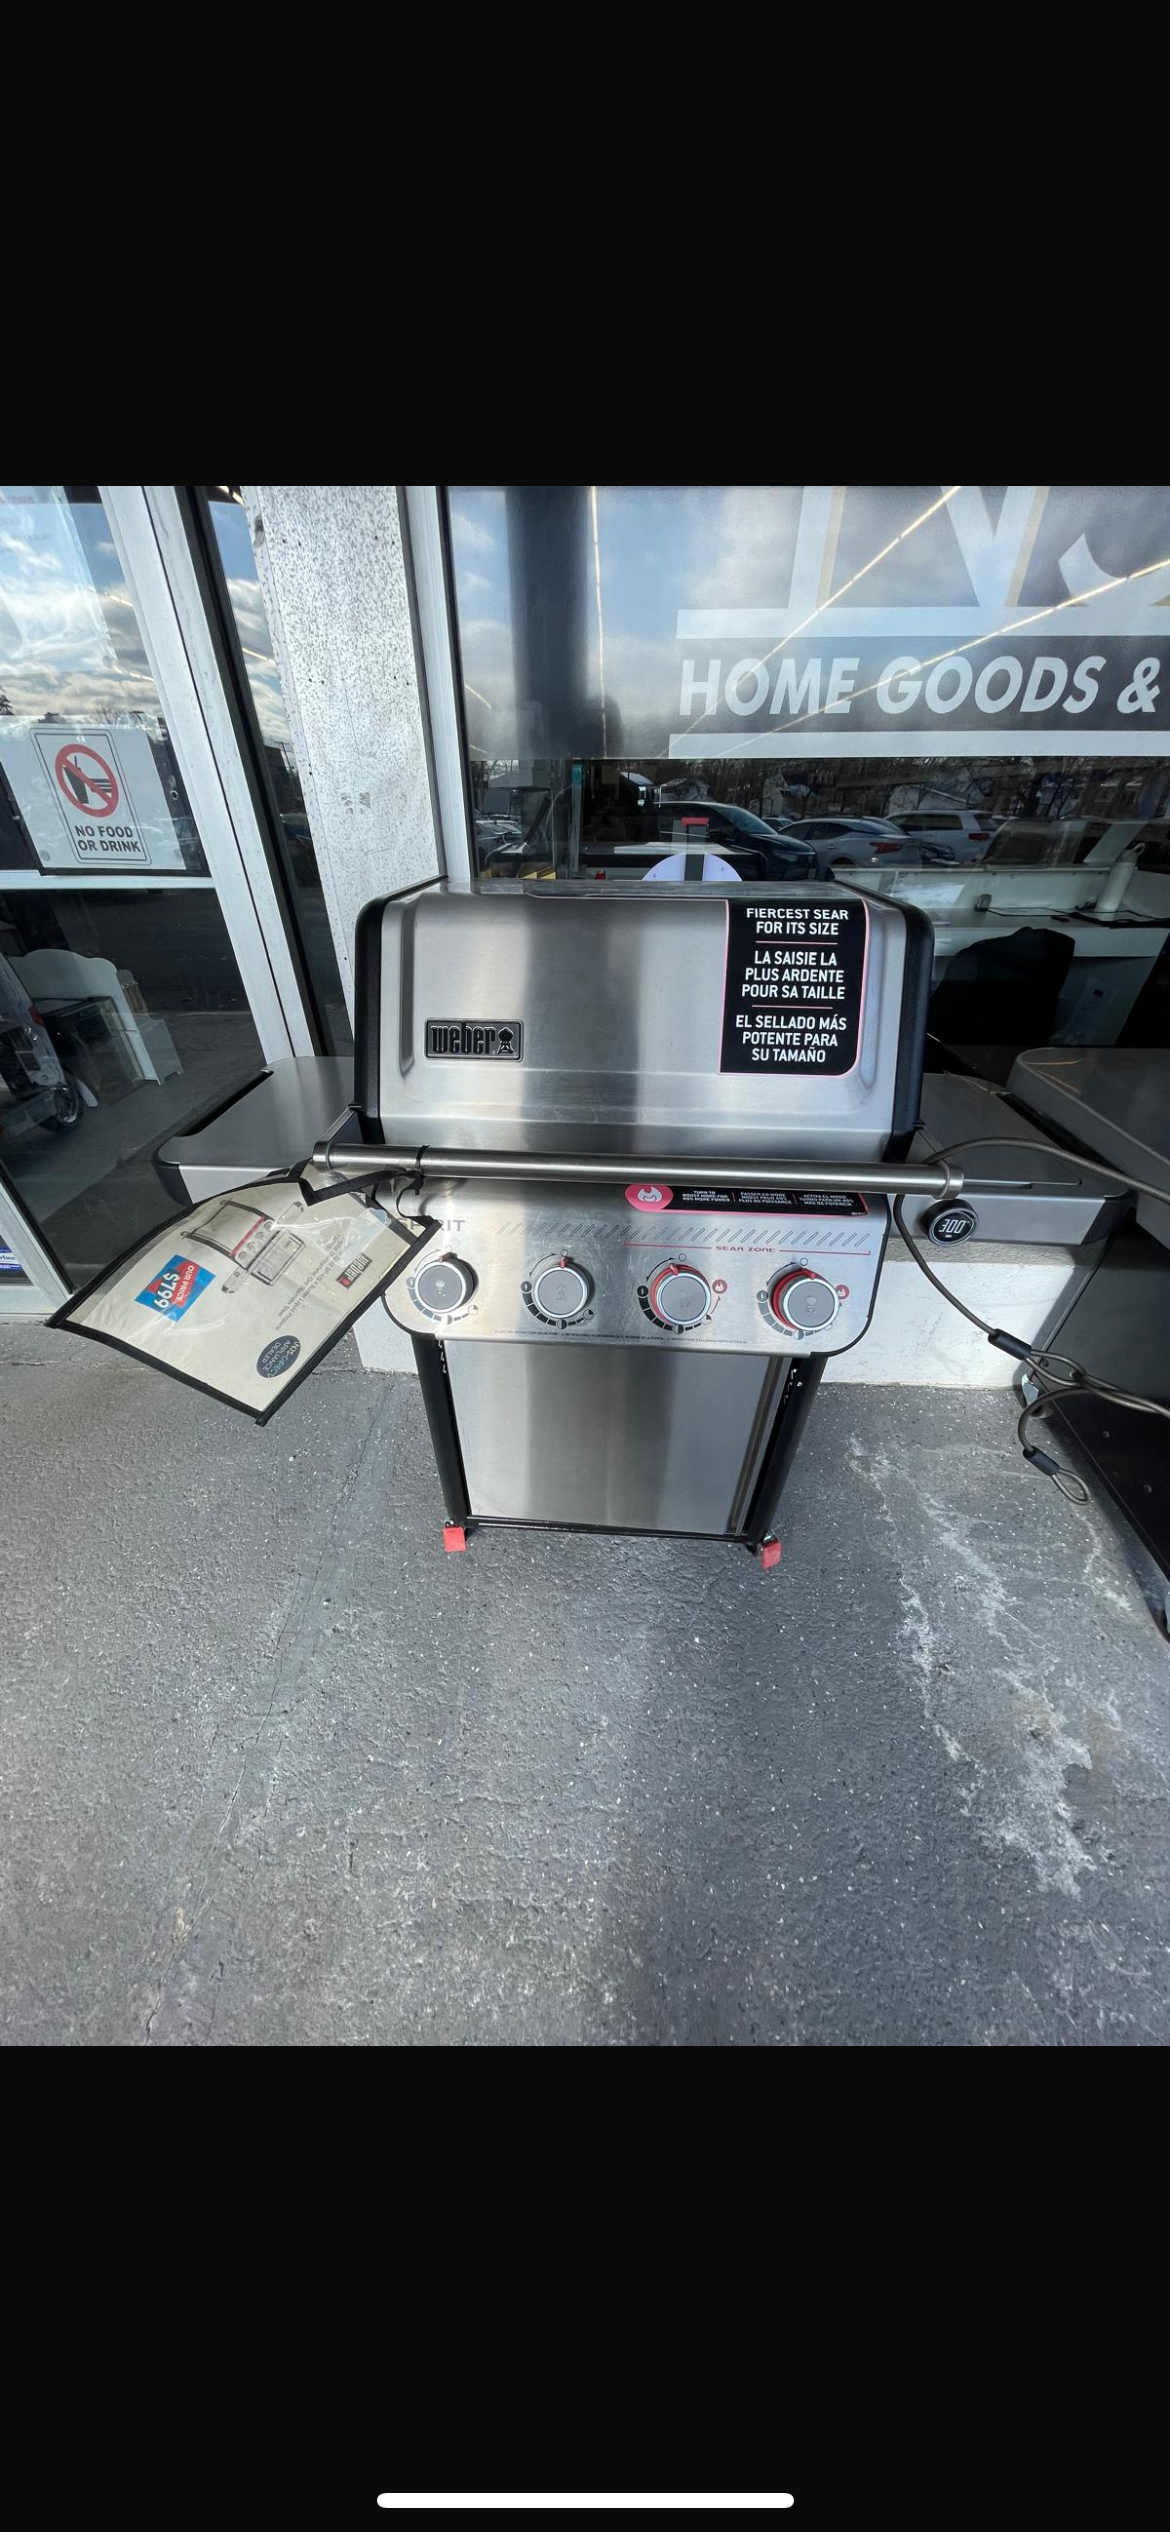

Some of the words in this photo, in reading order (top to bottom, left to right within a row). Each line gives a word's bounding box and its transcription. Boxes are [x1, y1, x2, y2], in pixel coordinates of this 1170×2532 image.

[679, 656, 860, 716] HOME
[877, 655, 1106, 714] GOODS
[1117, 657, 1161, 714] &
[75, 825, 95, 837] NO
[96, 826, 133, 838] FOOD
[78, 840, 97, 851] OR
[101, 841, 141, 852] DRINK
[746, 908, 810, 919] FIERCEST
[814, 909, 849, 920] SEAR
[756, 921, 783, 934] FOR
[786, 922, 806, 935] ITS
[809, 923, 839, 935] SIZE
[754, 950, 771, 964] LA
[774, 951, 817, 965] SAISIE
[820, 952, 837, 966] LA
[745, 968, 779, 981] PLUS
[782, 969, 844, 983] ARDENTE
[742, 984, 778, 998] POUR
[781, 985, 799, 998] SA
[801, 985, 845, 1000] TAILLE
[736, 1015, 752, 1028] EL
[755, 1015, 815, 1030] SELLADO
[819, 1013, 847, 1030] MÁS
[430, 1022, 496, 1054] weber
[742, 1031, 801, 1046] POTENTE
[804, 1033, 838, 1047] PARA
[752, 1048, 769, 1061] SU
[773, 1046, 826, 1063] TAMAÑO
[184, 1265, 195, 1280] OUR
[347, 1254, 370, 1281] weber
[154, 1272, 180, 1308] $799
[176, 1281, 189, 1301] PRICE
[262, 1341, 281, 1363] DEALER
[263, 1340, 291, 1371] APPLIANCE
